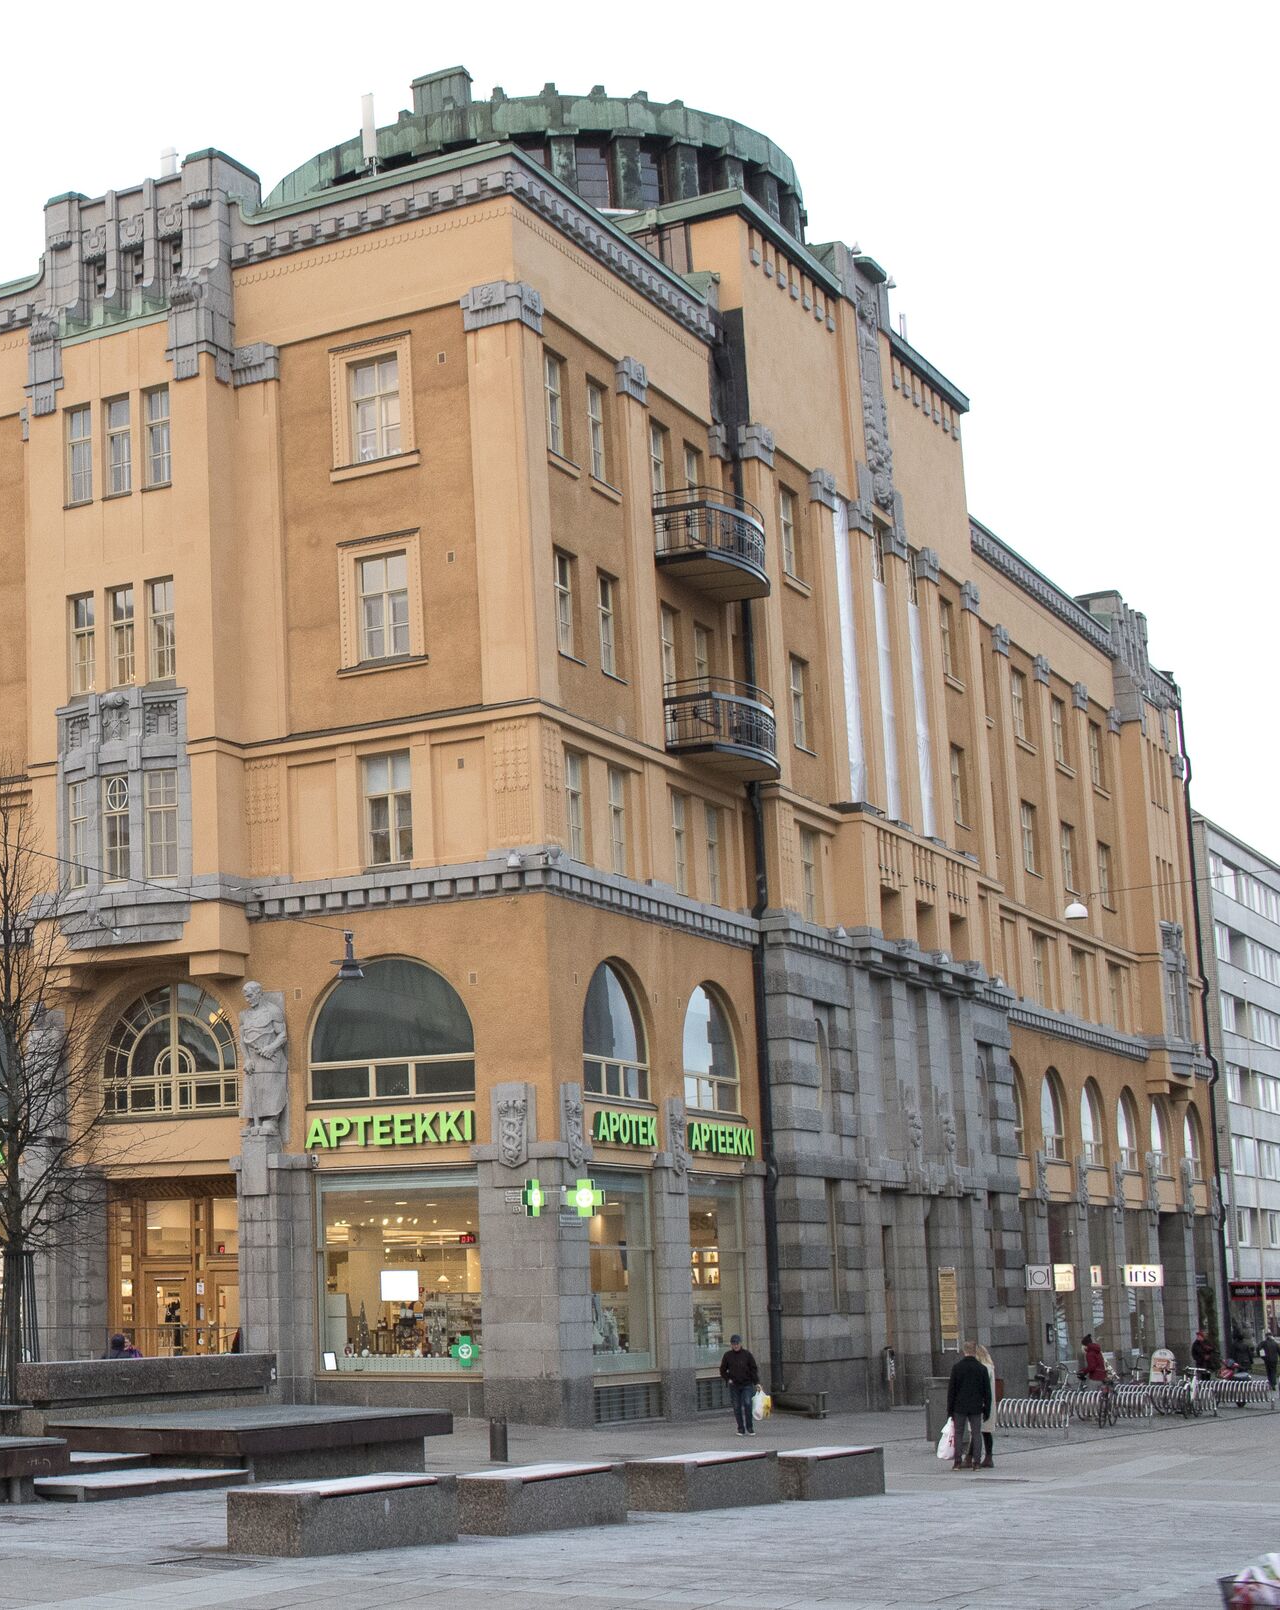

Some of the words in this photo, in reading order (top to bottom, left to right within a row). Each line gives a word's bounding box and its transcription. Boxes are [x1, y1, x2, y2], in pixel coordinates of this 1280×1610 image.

[304, 1109, 474, 1149] APTEEKKI
[595, 1110, 659, 1147] APOTEK
[689, 1121, 756, 1157] APTEEKKI
[1128, 1265, 1157, 1283] iris
